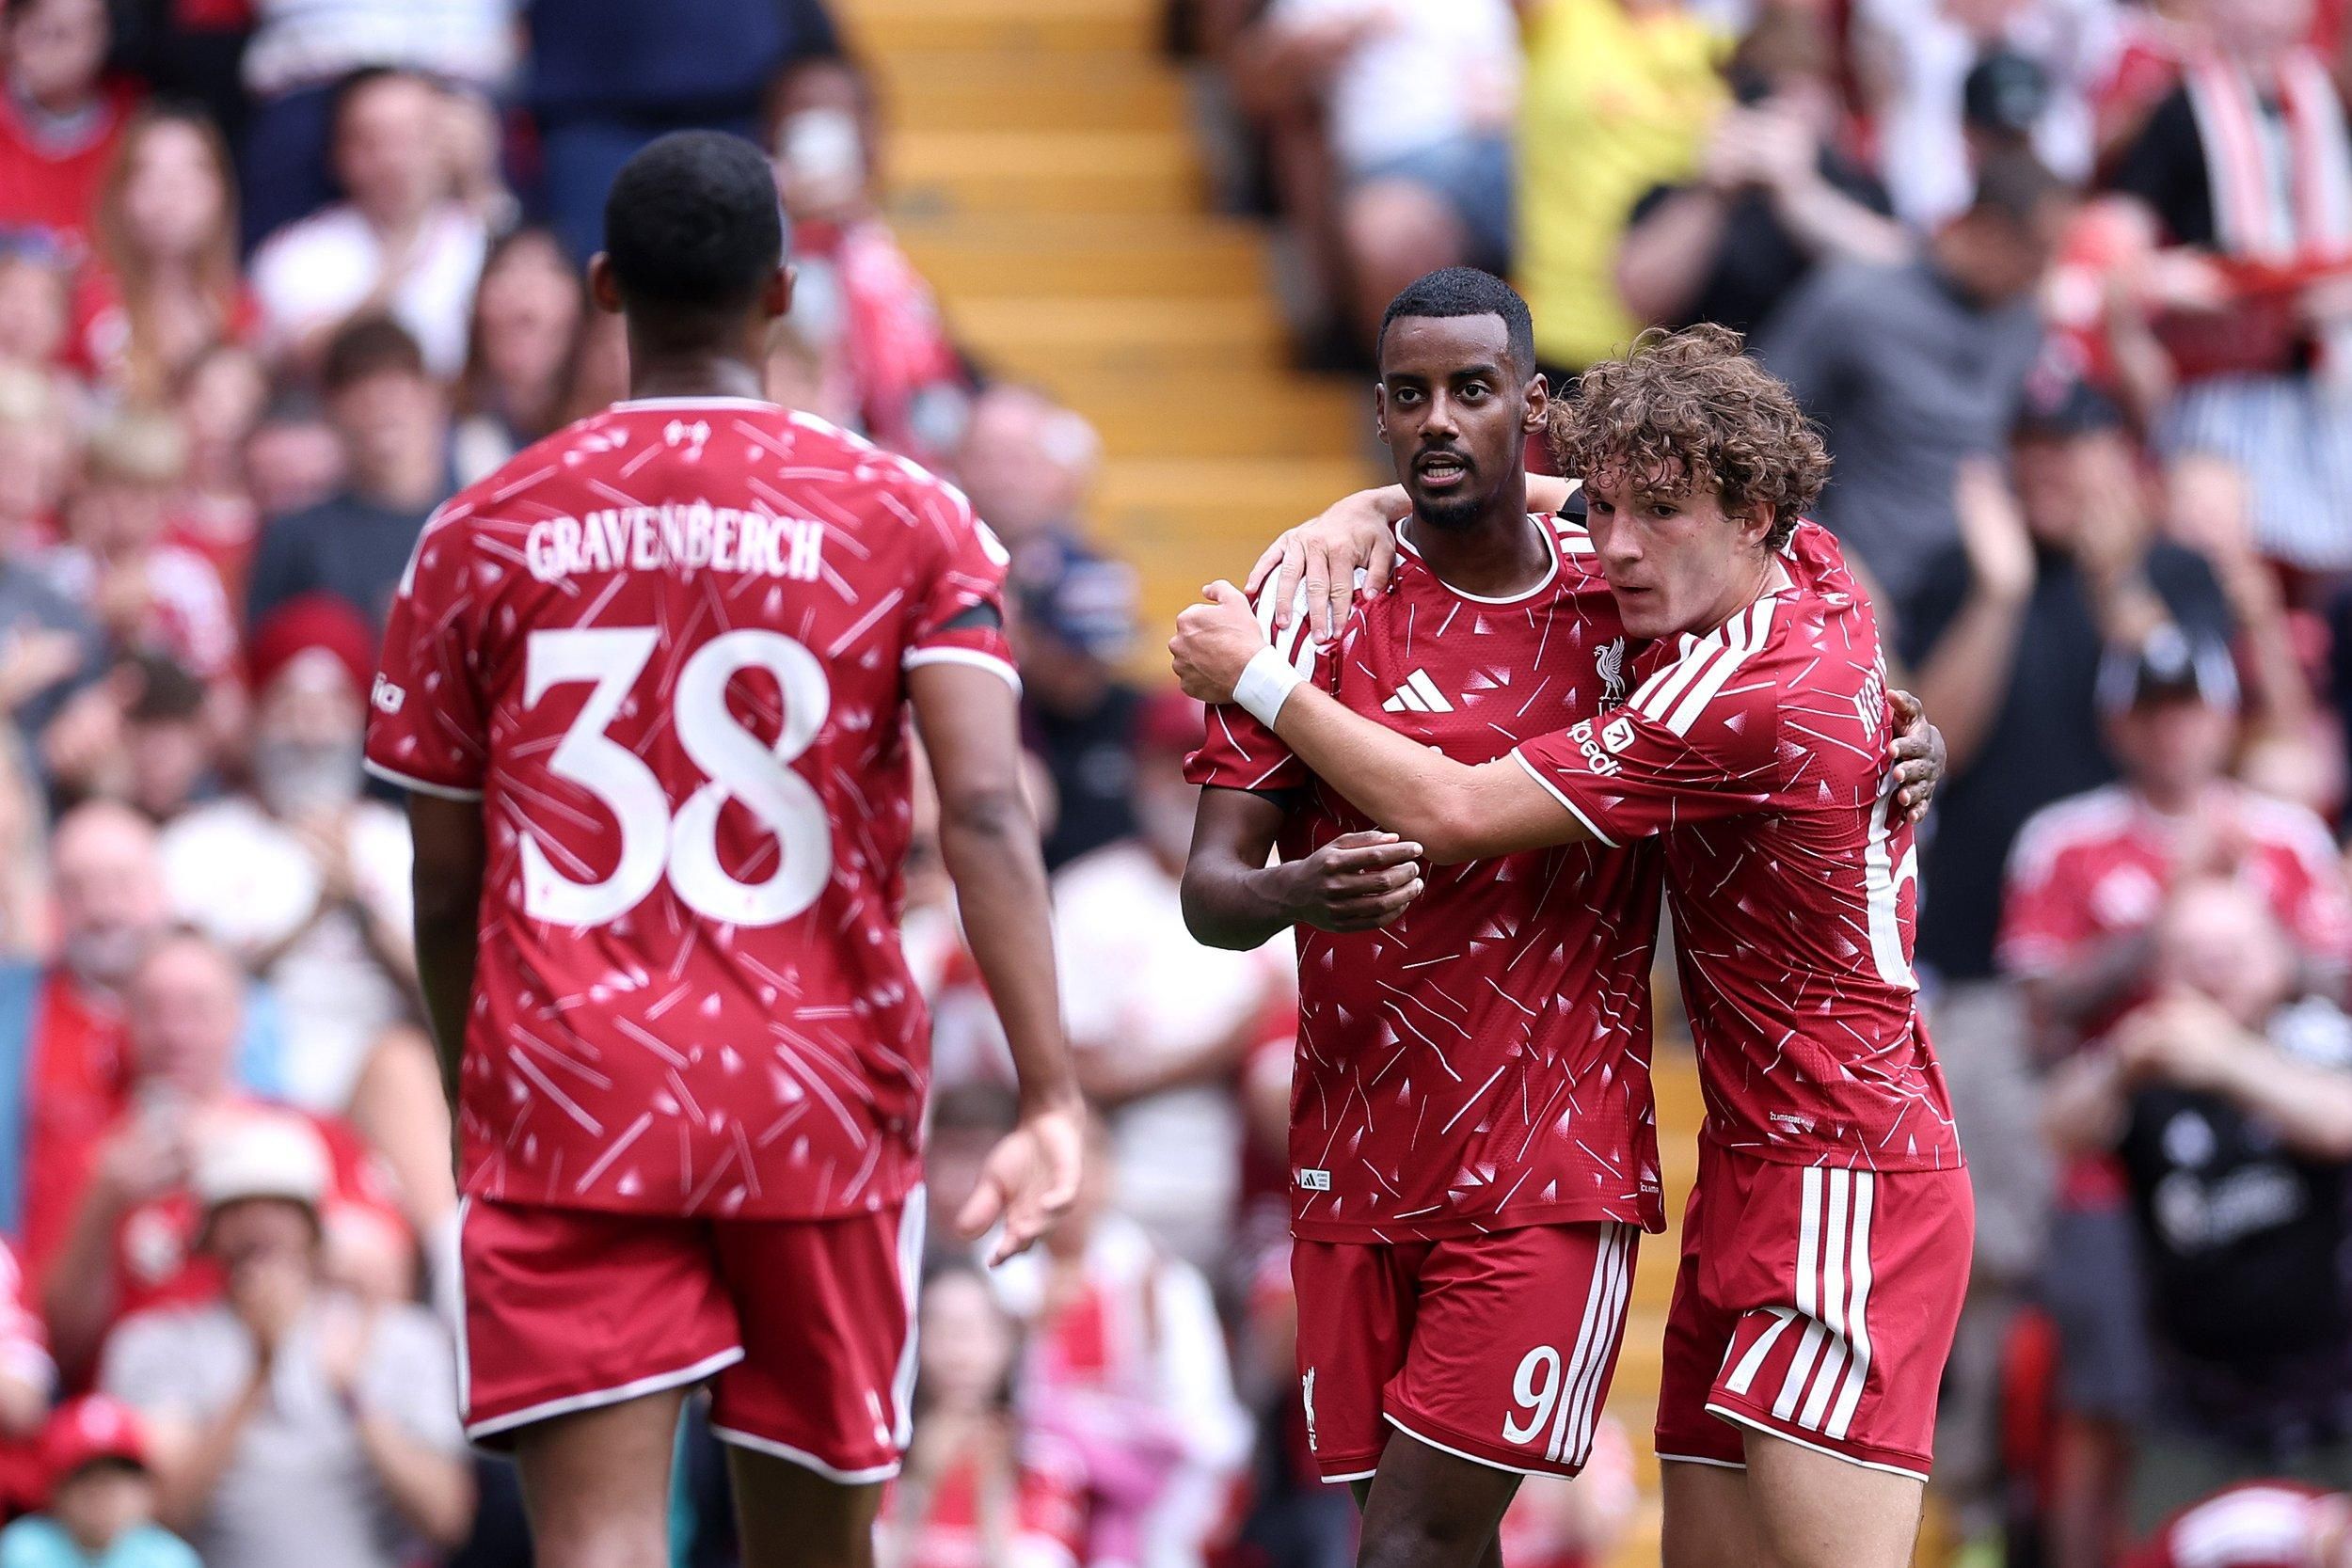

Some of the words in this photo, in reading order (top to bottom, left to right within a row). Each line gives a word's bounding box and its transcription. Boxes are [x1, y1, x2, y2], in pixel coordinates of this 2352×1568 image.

[525, 504, 824, 582] GRAVENBERCH
[520, 625, 833, 927] 38
[1502, 1345, 1561, 1444] 9
